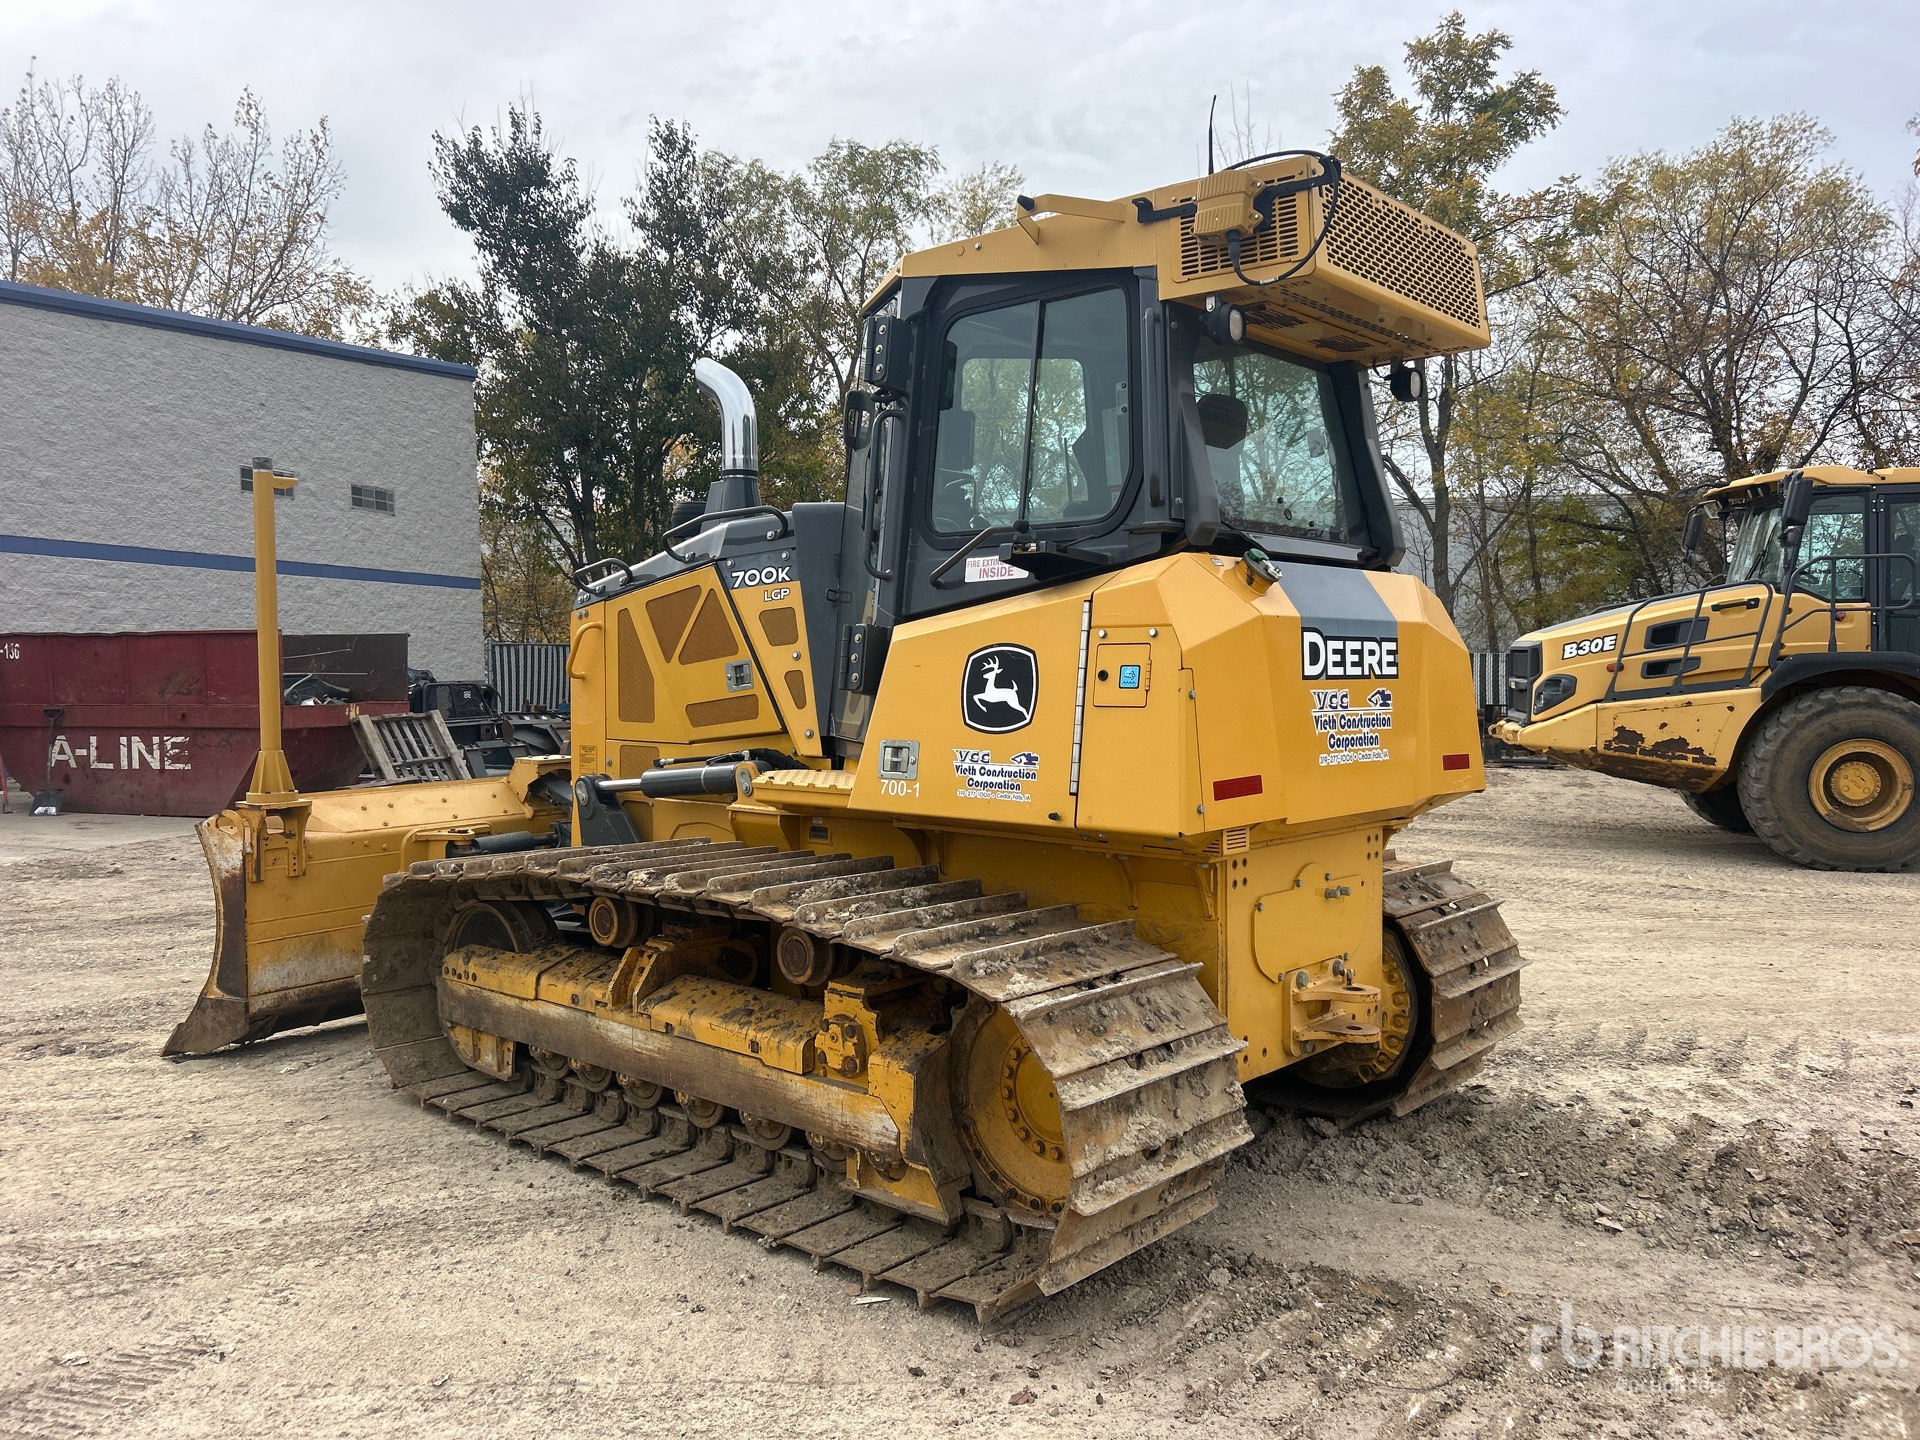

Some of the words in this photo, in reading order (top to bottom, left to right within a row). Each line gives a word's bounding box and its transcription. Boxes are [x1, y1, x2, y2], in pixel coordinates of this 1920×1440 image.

[967, 560, 981, 568] FIRE
[979, 566, 1014, 579] INSIDE
[731, 566, 792, 588] 700K
[764, 588, 790, 602] LGP
[1302, 630, 1398, 677] DEERE
[1562, 635, 1618, 660] B30E
[1313, 691, 1349, 710] VCC
[1314, 714, 1337, 731] Vieth
[1339, 713, 1391, 730] Construction
[1328, 731, 1379, 751] Corporation
[51, 735, 191, 770] A-LINE
[956, 750, 990, 763] VCC
[955, 764, 977, 776] Vieth
[979, 766, 1037, 780] Construction
[880, 779, 920, 798] 700-1
[967, 777, 1021, 791] Corporation
